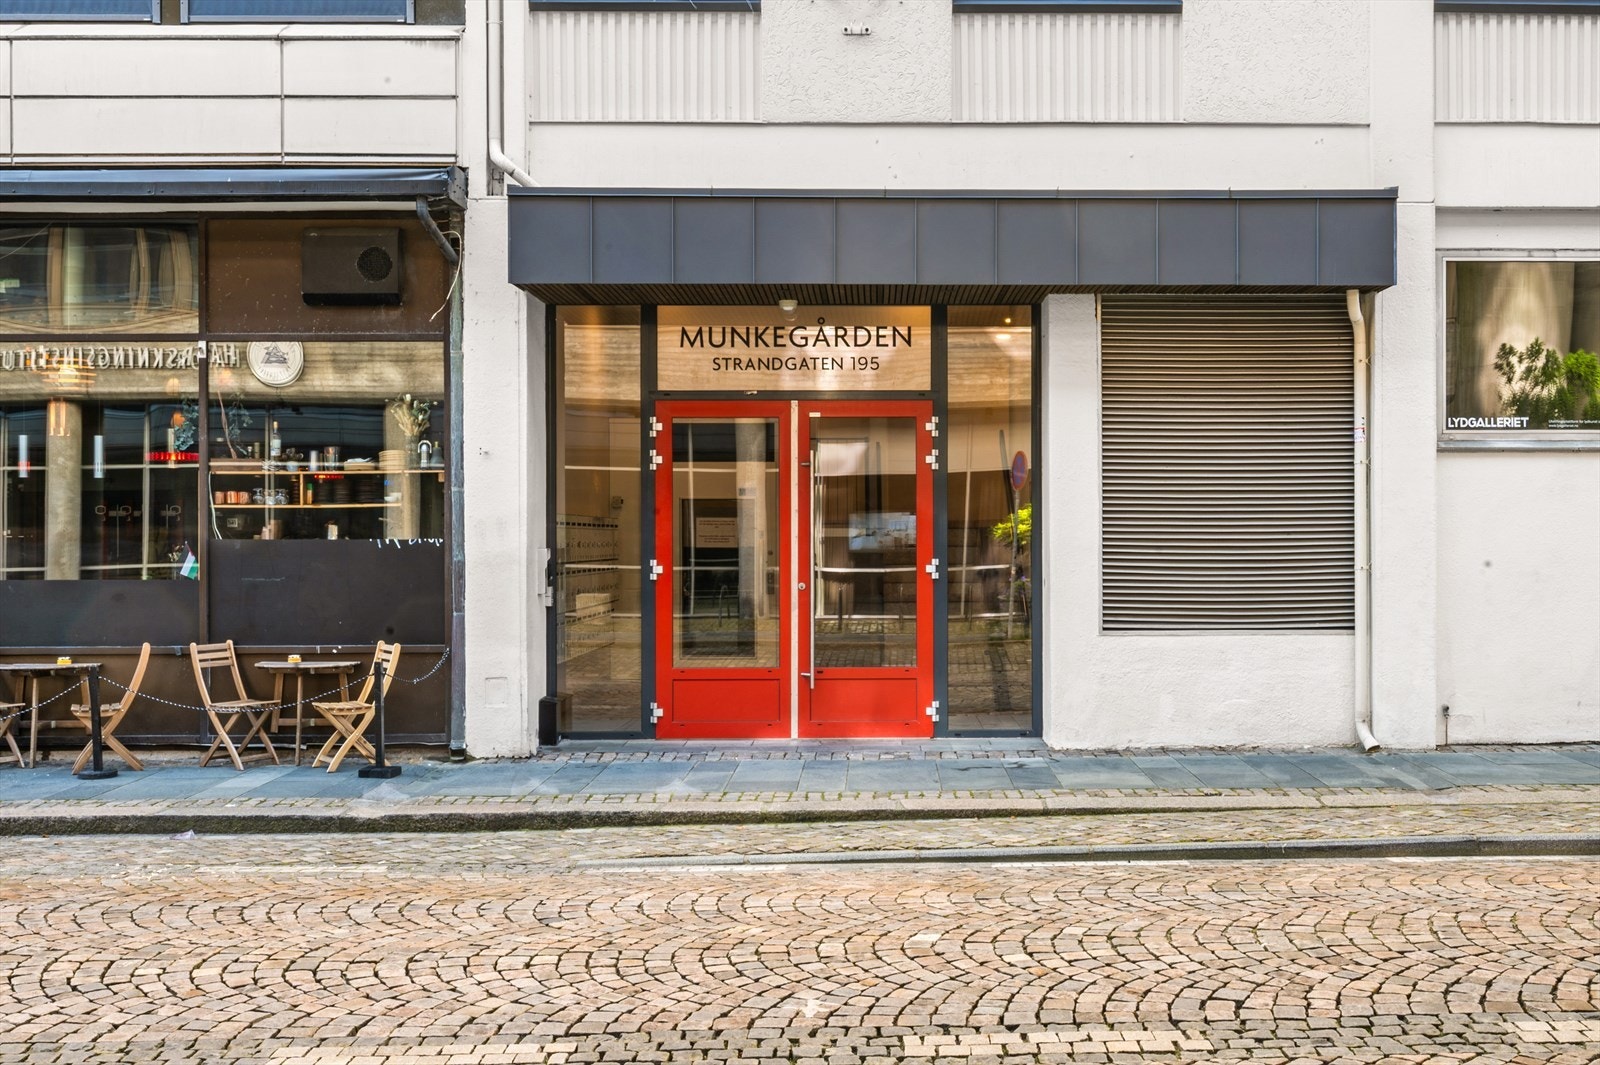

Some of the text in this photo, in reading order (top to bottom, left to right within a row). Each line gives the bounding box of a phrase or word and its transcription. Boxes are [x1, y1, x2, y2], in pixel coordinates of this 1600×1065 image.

[680, 317, 911, 348] MUNKEGÅRDEN
[712, 356, 880, 371] STRANDGATEN 195
[1447, 417, 1529, 428] LYDGALLERIET
